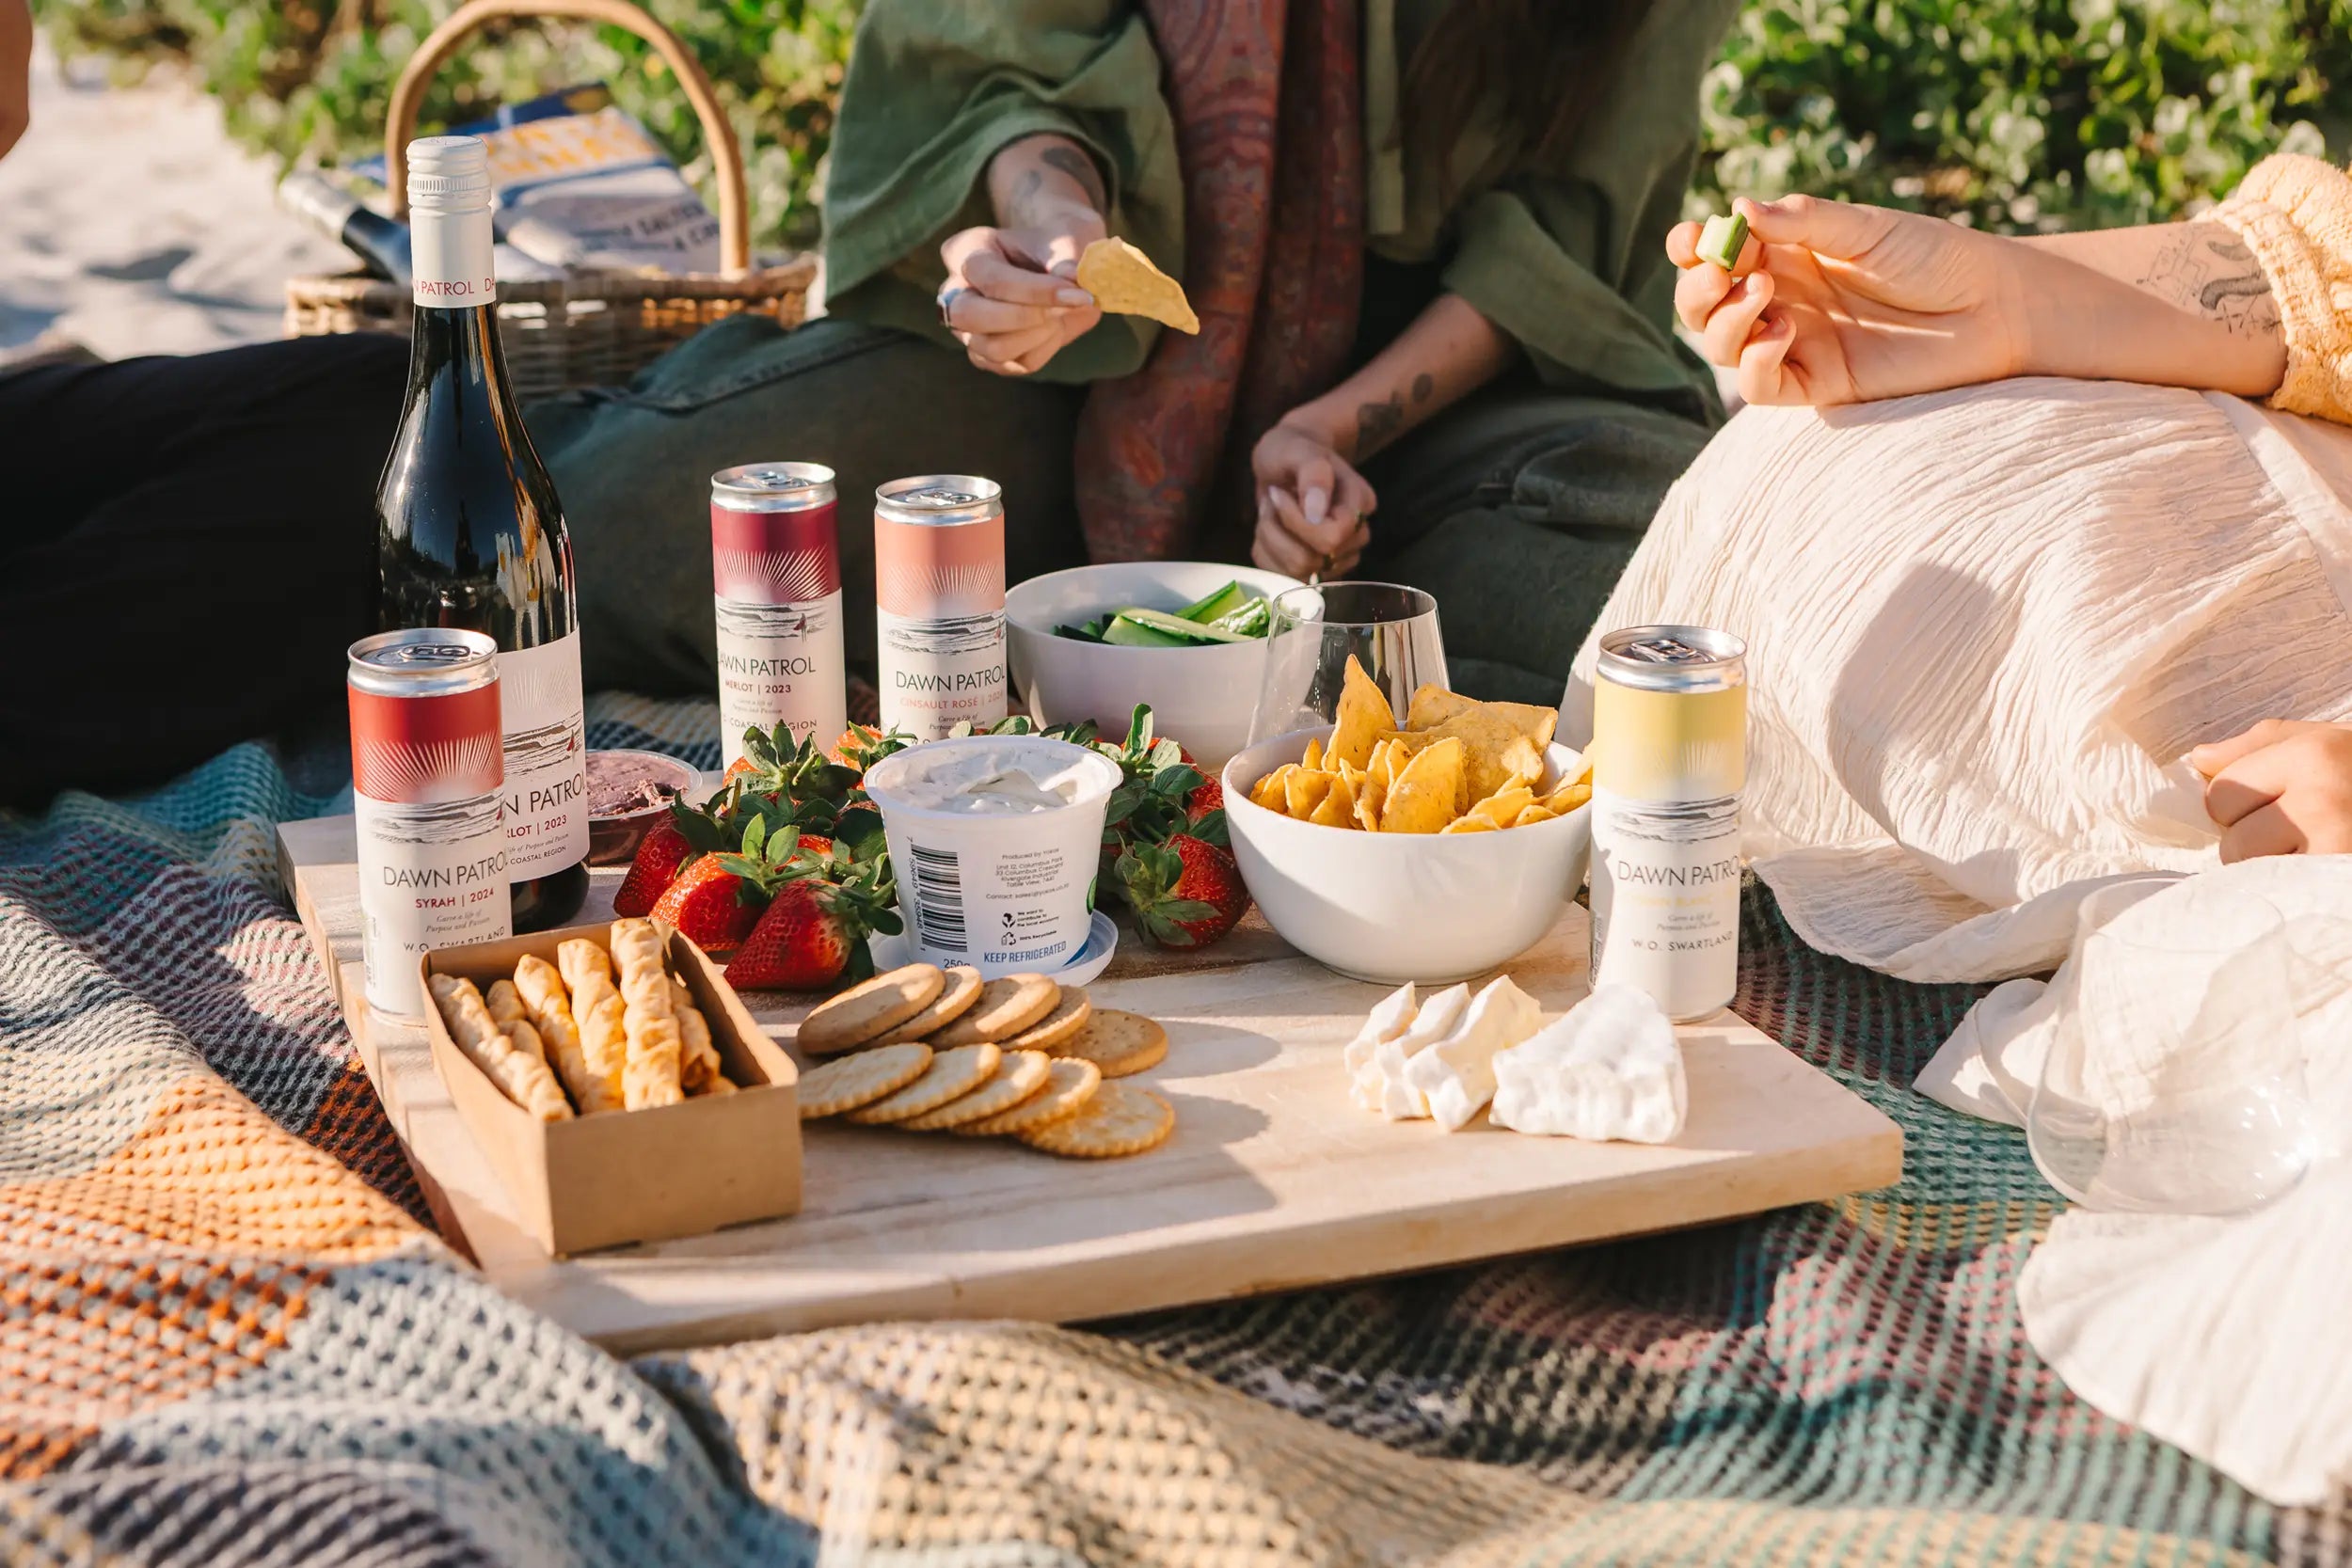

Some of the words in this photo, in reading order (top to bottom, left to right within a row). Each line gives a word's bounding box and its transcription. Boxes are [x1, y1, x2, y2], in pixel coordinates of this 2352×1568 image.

[421, 280, 474, 295] PATROL
[750, 657, 816, 676] PATROL
[725, 679, 753, 692] MERLOT
[765, 685, 791, 693] 2023
[897, 671, 951, 691] DAWN
[957, 664, 1005, 690] PATROL
[952, 696, 977, 708] ROSÉ
[545, 815, 567, 831] 2023
[510, 853, 542, 864] COASTAL
[544, 846, 566, 858] REGION
[384, 866, 451, 887] DAWN
[1618, 861, 1685, 886] DAWN
[1692, 855, 1739, 886] PATRO
[416, 896, 455, 909] SYRAH
[470, 888, 494, 903] 2024
[1668, 930, 1732, 951] SWARTLAND
[984, 952, 1007, 963] KEEP
[1009, 941, 1066, 962] REFRIGERATED
